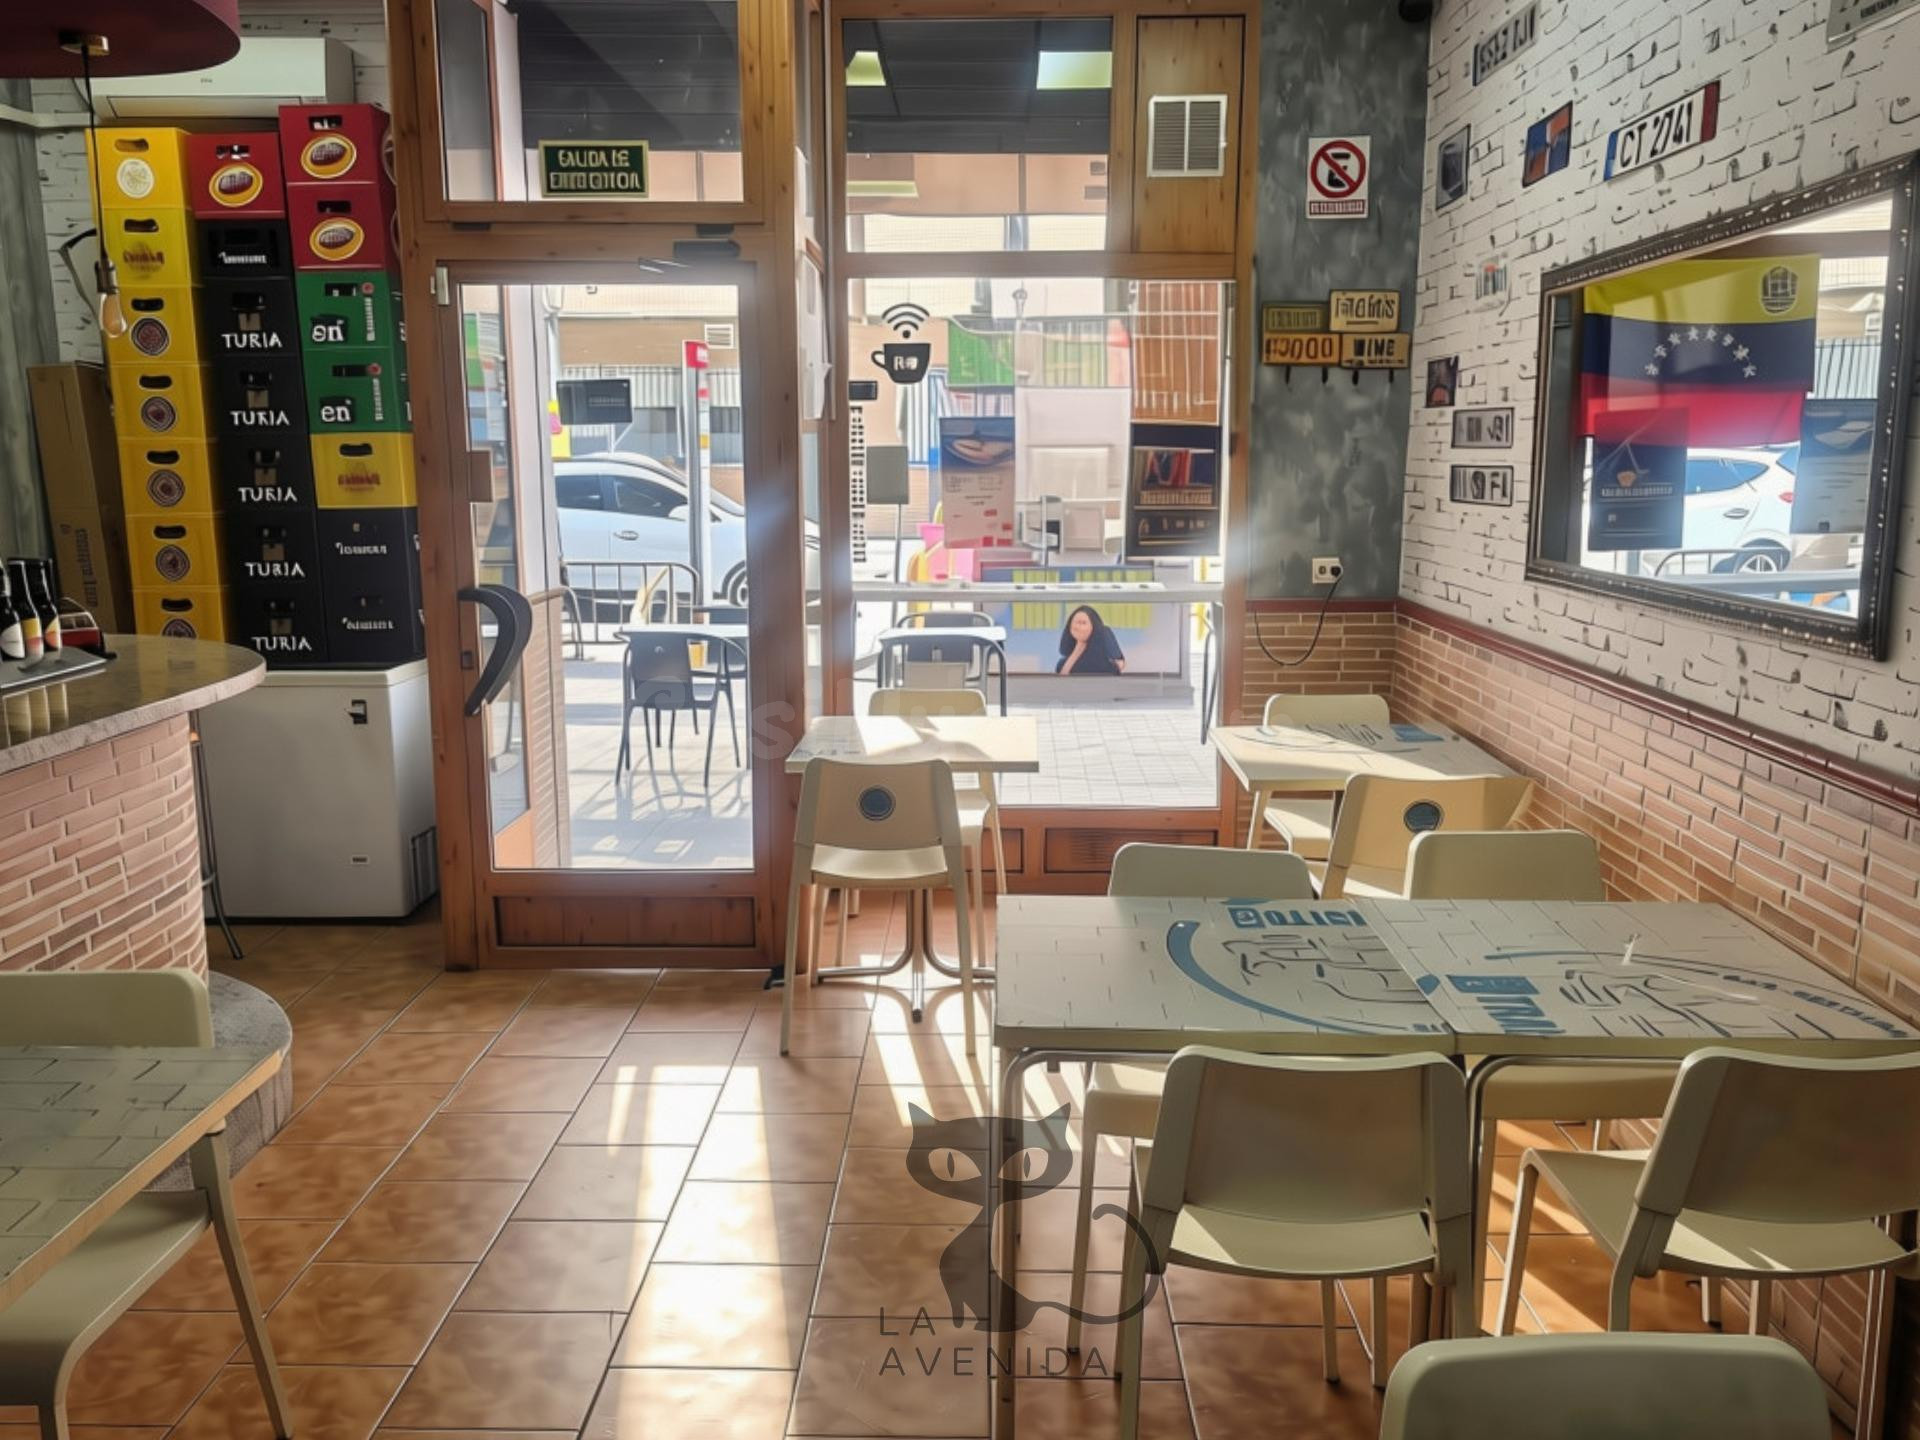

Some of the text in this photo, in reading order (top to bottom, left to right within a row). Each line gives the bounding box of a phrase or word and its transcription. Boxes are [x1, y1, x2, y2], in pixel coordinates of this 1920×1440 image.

[221, 332, 283, 349] TURIA
[229, 410, 290, 426] TURIA
[238, 487, 298, 502] TURIA
[245, 562, 306, 577] TURIA
[252, 636, 313, 651] TURIA
